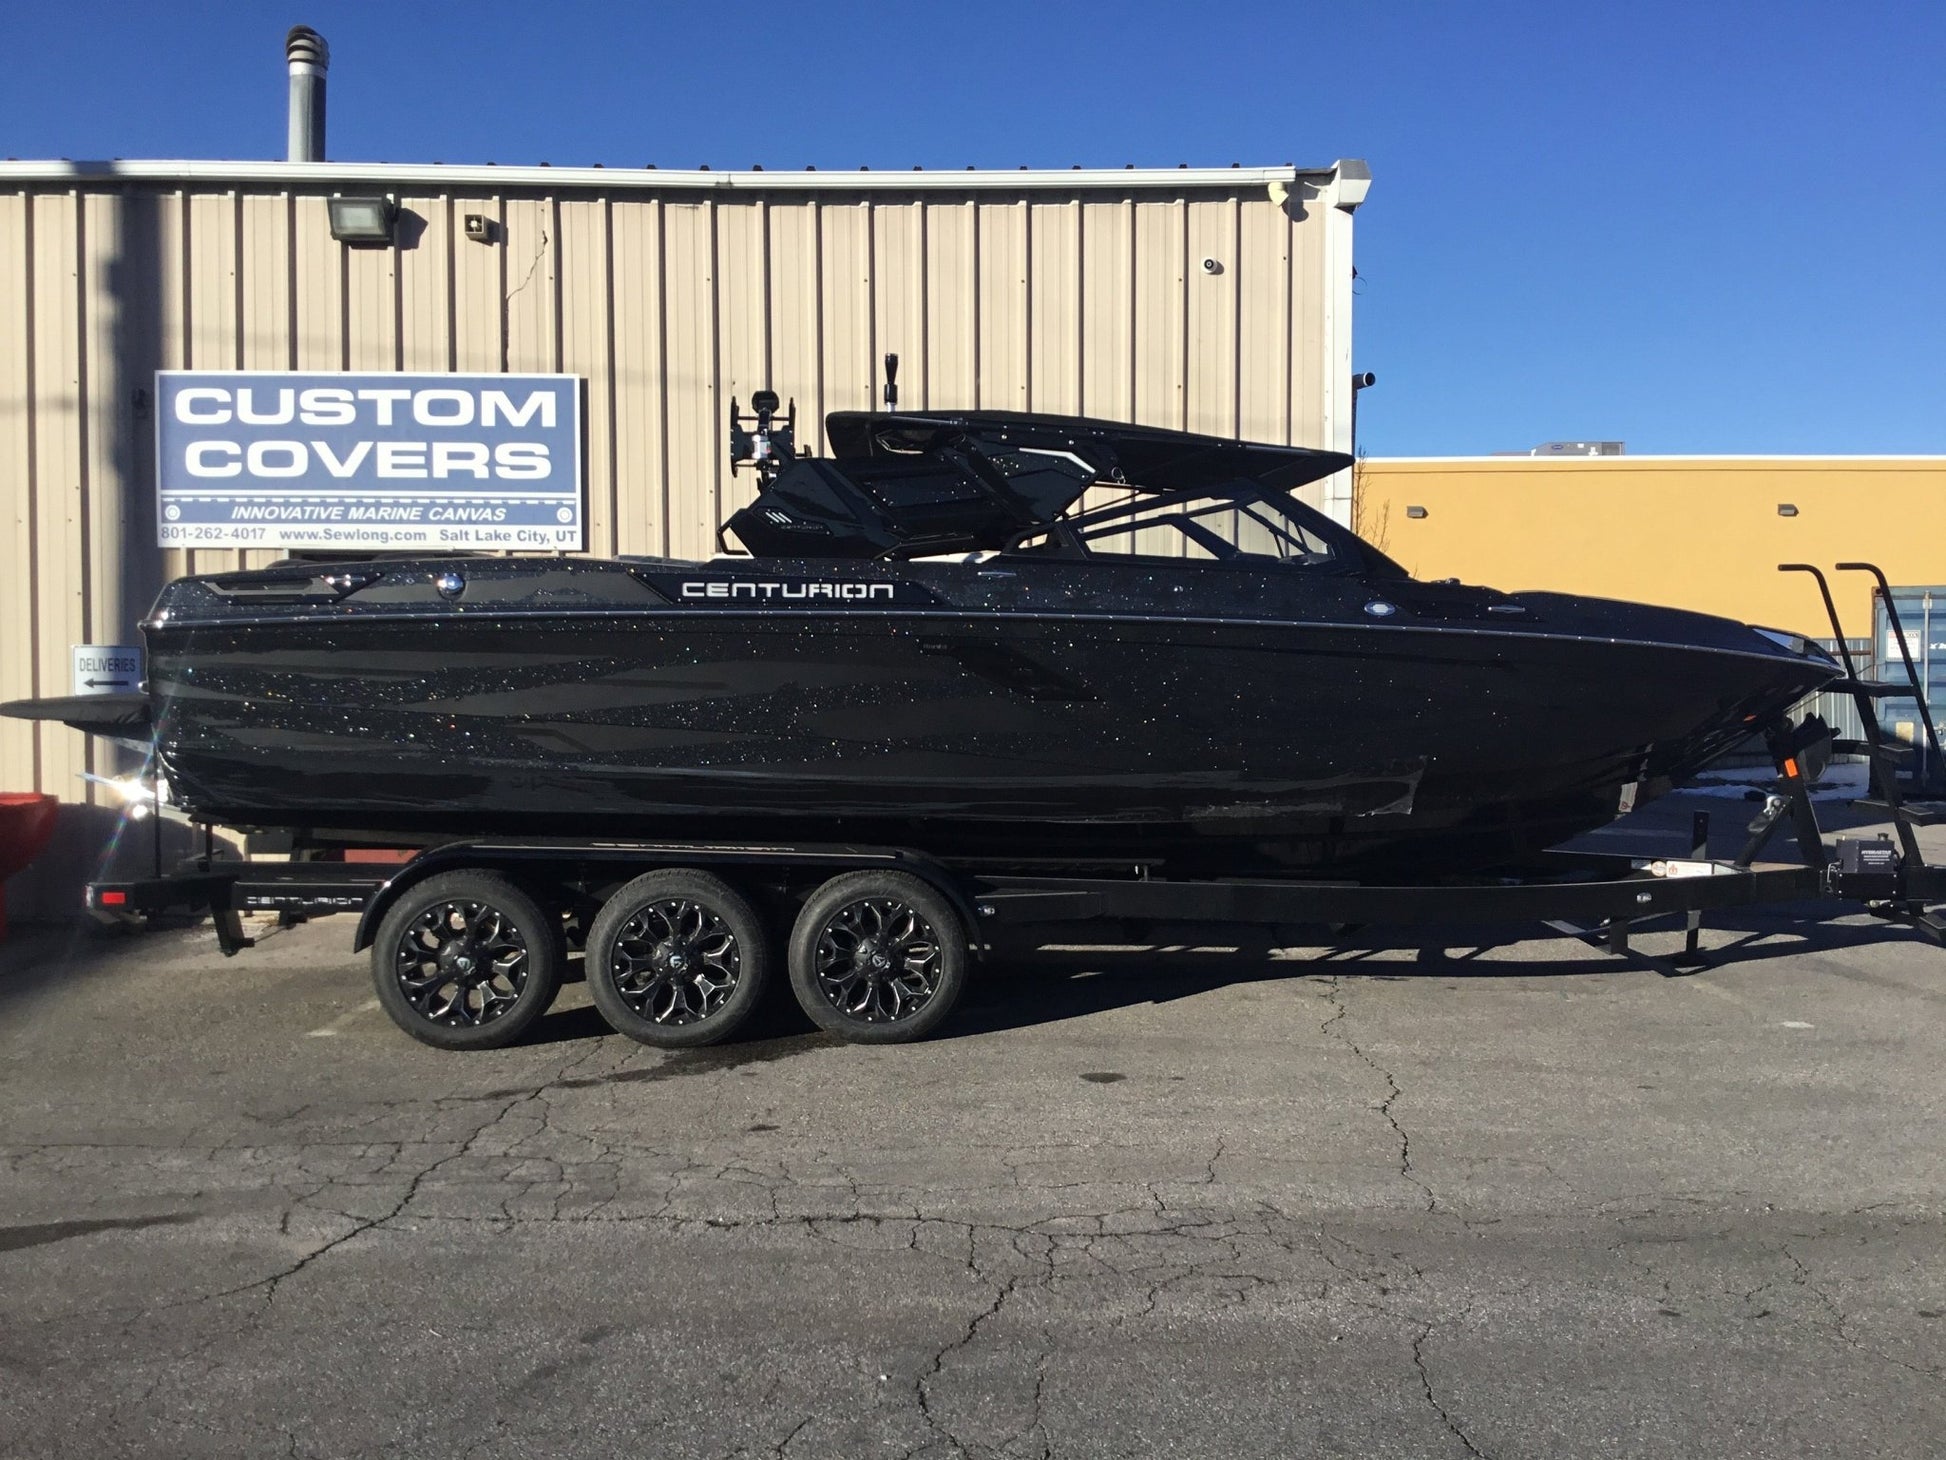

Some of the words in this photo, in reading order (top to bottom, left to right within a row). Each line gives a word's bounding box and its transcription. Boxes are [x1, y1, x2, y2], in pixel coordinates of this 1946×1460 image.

[174, 387, 557, 428] CUSTOM
[184, 440, 552, 480] COVERS
[231, 506, 345, 520] INNOVATIVE
[347, 507, 423, 520] MARINE
[428, 507, 507, 521] CANVAS
[160, 526, 266, 540] 801-262-4017
[279, 528, 427, 543] www.Sewlong.com
[439, 529, 470, 542] Salt
[475, 530, 512, 542] Lake
[516, 530, 550, 544] City,
[556, 530, 577, 542] UT
[682, 582, 894, 599] CENTURION
[79, 657, 136, 672] DELIVERIES
